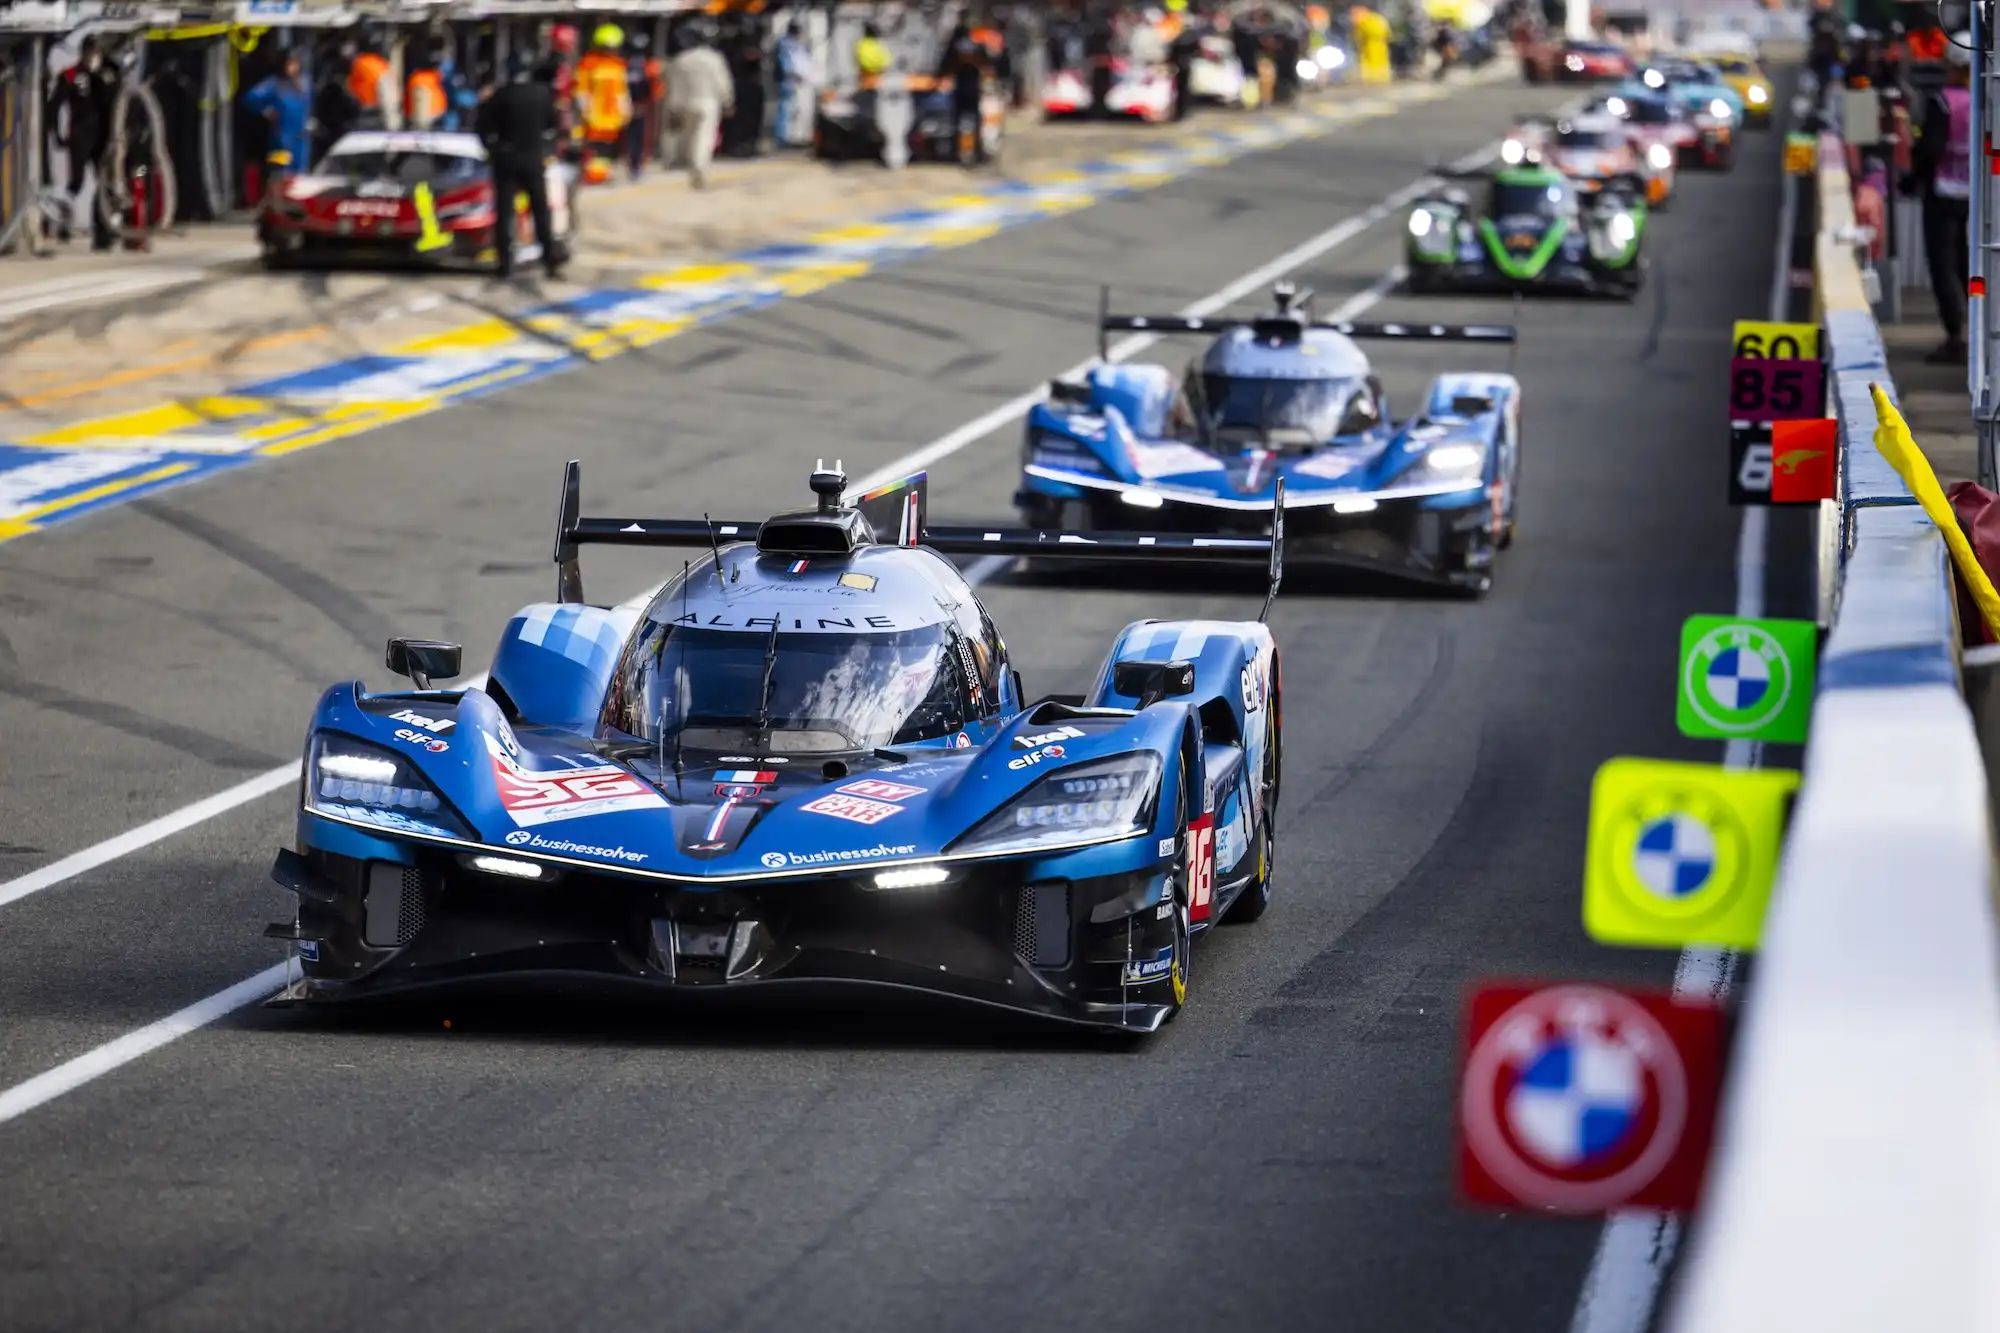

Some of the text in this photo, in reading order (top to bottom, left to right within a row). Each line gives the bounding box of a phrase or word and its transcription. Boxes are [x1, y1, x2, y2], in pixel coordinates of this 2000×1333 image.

[1737, 332, 1800, 361] 60
[1732, 367, 1803, 413] 85
[673, 612, 896, 630] ALPINE
[394, 729, 433, 744] elf
[1008, 751, 1042, 770] elf
[848, 780, 917, 800] HY
[810, 801, 882, 822] CAR
[530, 834, 649, 863] businessolver
[790, 843, 917, 865] businessolver
